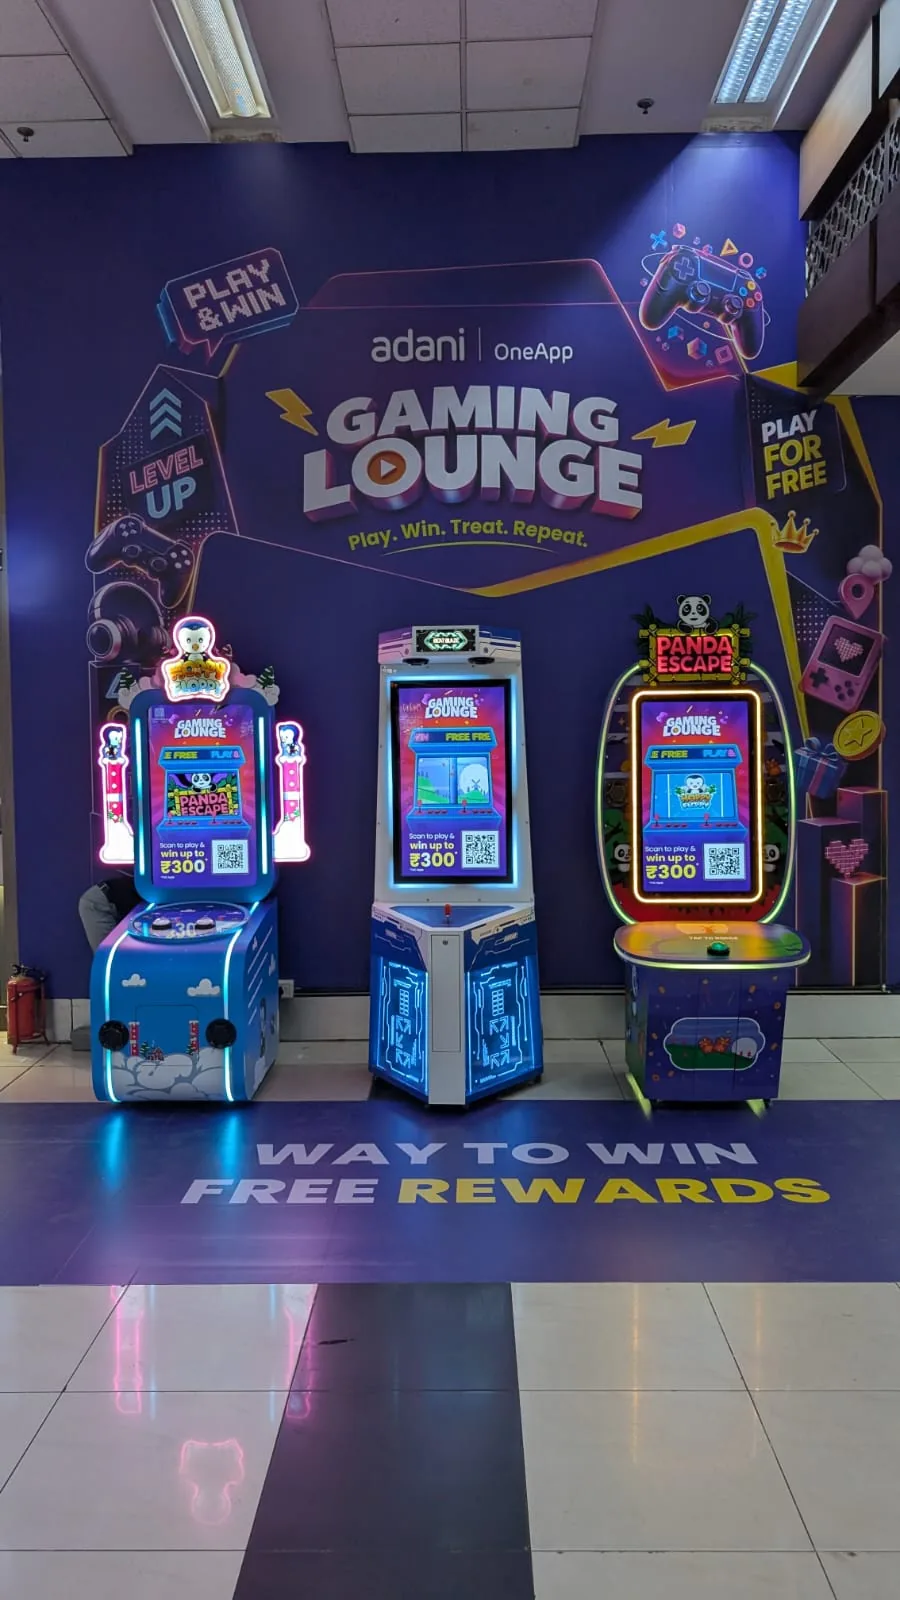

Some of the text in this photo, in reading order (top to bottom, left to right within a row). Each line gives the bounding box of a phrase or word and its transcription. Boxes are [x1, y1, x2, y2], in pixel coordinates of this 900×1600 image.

[183, 258, 270, 308] PLAY
[197, 283, 287, 331] & WIN
[371, 328, 573, 364] adani OneApp
[326, 385, 619, 444] GAMING
[761, 409, 817, 443] PLAY
[764, 434, 822, 473] FOR
[129, 445, 204, 494] LEVEL
[303, 434, 643, 516] LOUNGE
[766, 460, 827, 500] FREE
[146, 476, 197, 518] UP
[348, 519, 588, 550] Play. Win. Treat. Repeat.
[656, 636, 733, 655] PANDA
[657, 655, 732, 673] ESCAPE
[428, 696, 474, 708] GAMING
[425, 705, 478, 719] LOUNGE
[177, 718, 222, 729] GAMING
[662, 724, 721, 737] LOUNGE
[666, 715, 717, 728] GAMING
[174, 727, 226, 738] LOUNGE
[445, 732, 471, 741] FREE
[661, 750, 688, 758] FREE
[180, 793, 228, 807] PANDA
[181, 803, 229, 816] ESCAPE
[160, 849, 205, 860] win up to
[185, 842, 198, 850] play
[409, 841, 455, 852] win up to
[646, 853, 696, 864] win up to
[256, 1142, 758, 1165] WAY TO WIN
[180, 1178, 830, 1204] FREE REWARDS
